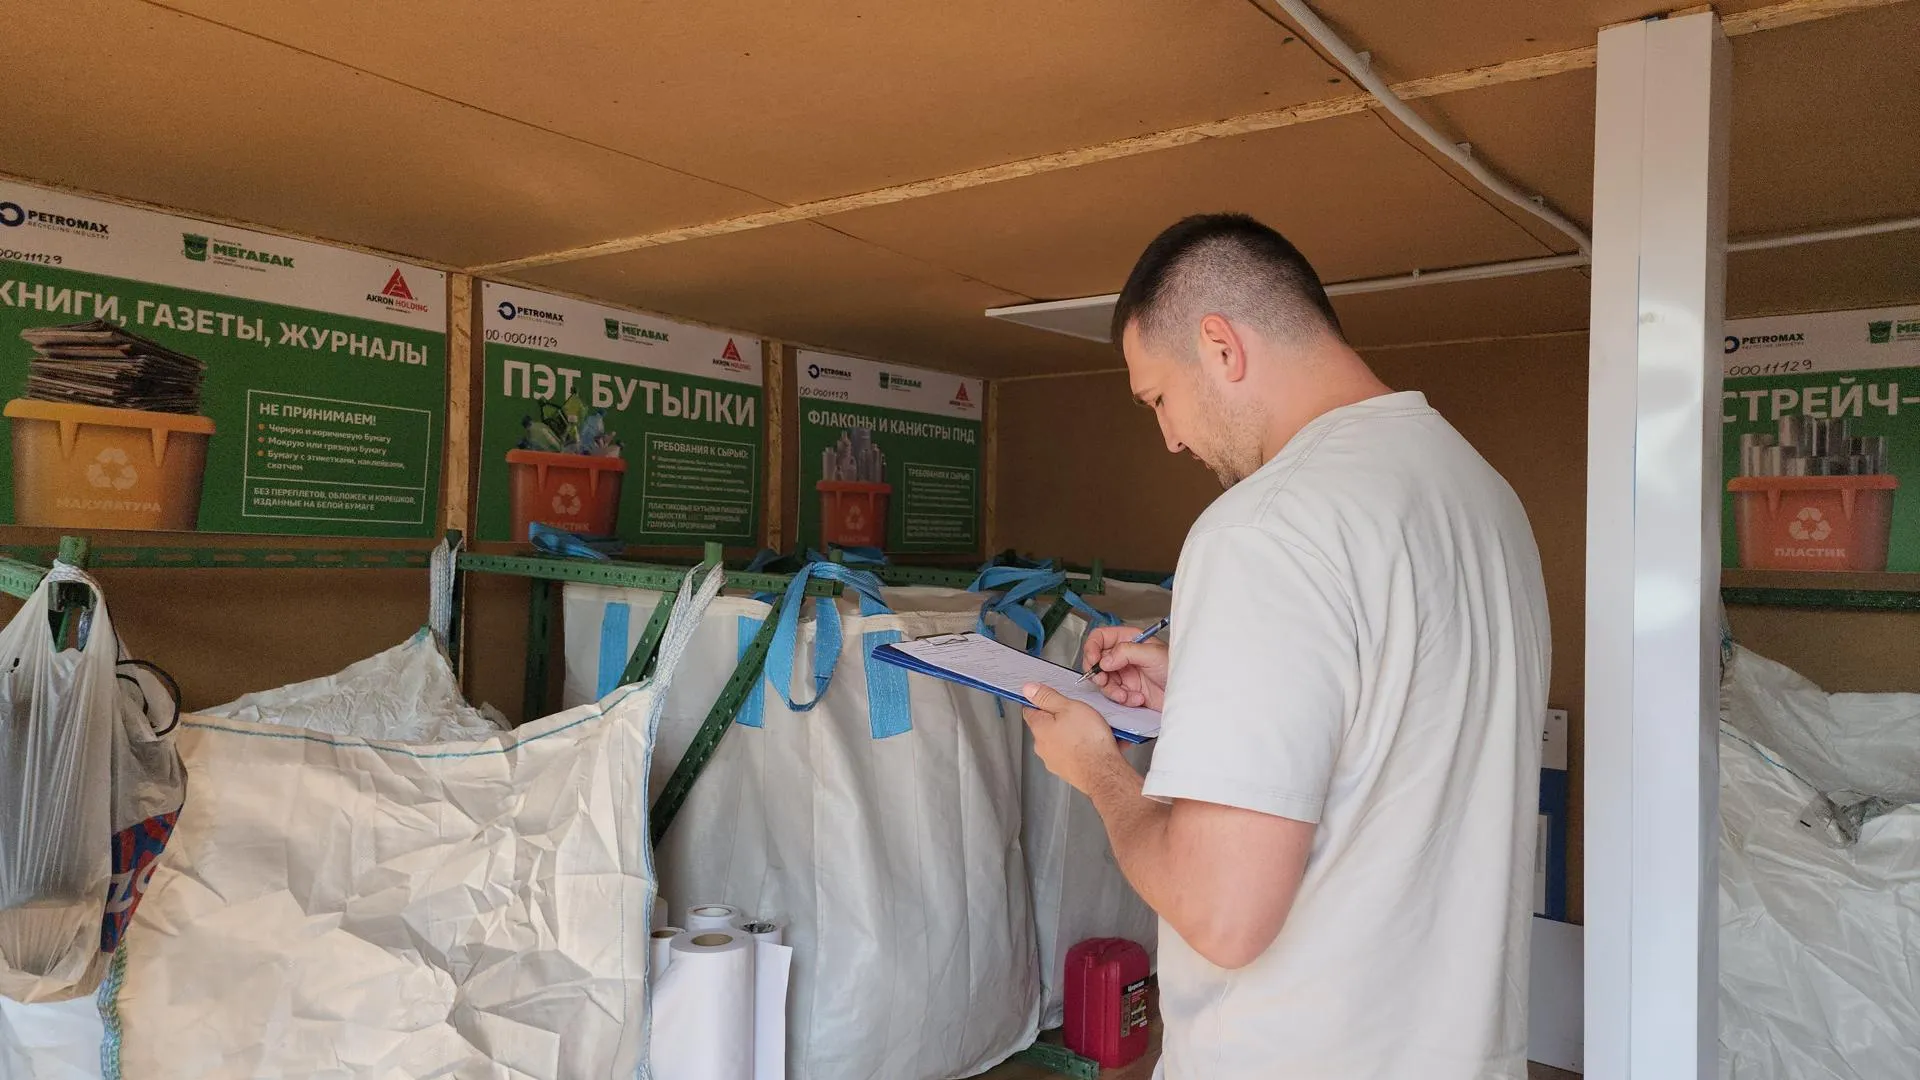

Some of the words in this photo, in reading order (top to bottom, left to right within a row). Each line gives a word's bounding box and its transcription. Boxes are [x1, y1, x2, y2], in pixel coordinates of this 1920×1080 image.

[28, 210, 109, 234] PETROMAX
[213, 243, 295, 269] МЕГАБАК
[366, 293, 394, 306] AKRON
[395, 300, 429, 313] HOLDING
[517, 306, 564, 322] PETROMAX
[136, 299, 271, 348] ГАЗЕТЫ,
[279, 321, 428, 366] ЖУРНАЛЫ
[622, 325, 669, 342] МЕГАБАК
[1741, 333, 1805, 345] PETROMAX
[503, 359, 581, 400] ПЭТ
[591, 372, 755, 428] БУТЫЛКИ
[259, 403, 279, 416] НЕ
[282, 405, 377, 426] ПРИНИМАЕМ!
[268, 423, 304, 435] Черную
[311, 430, 363, 442] коричневую
[807, 409, 876, 432] ФЛАКОНЫ
[878, 418, 888, 432] И
[890, 419, 951, 441] КАНИСТРЫ
[952, 427, 976, 445] ПНД
[268, 436, 305, 449] Мокрую
[652, 440, 709, 455] ТРЕБОВАНИЯ
[267, 450, 299, 461] Бумагу
[266, 462, 303, 471] скотчем
[253, 487, 270, 496] БЕЗ
[328, 492, 368, 501] ОБЛОЖЕК
[253, 498, 303, 508] ИЗДАННЫЕ
[303, 500, 316, 508] НА
[316, 501, 344, 509] БЕЛОЙ
[344, 503, 375, 511] БУМАГЕ
[1774, 547, 1846, 558] ПЛАСТИК
